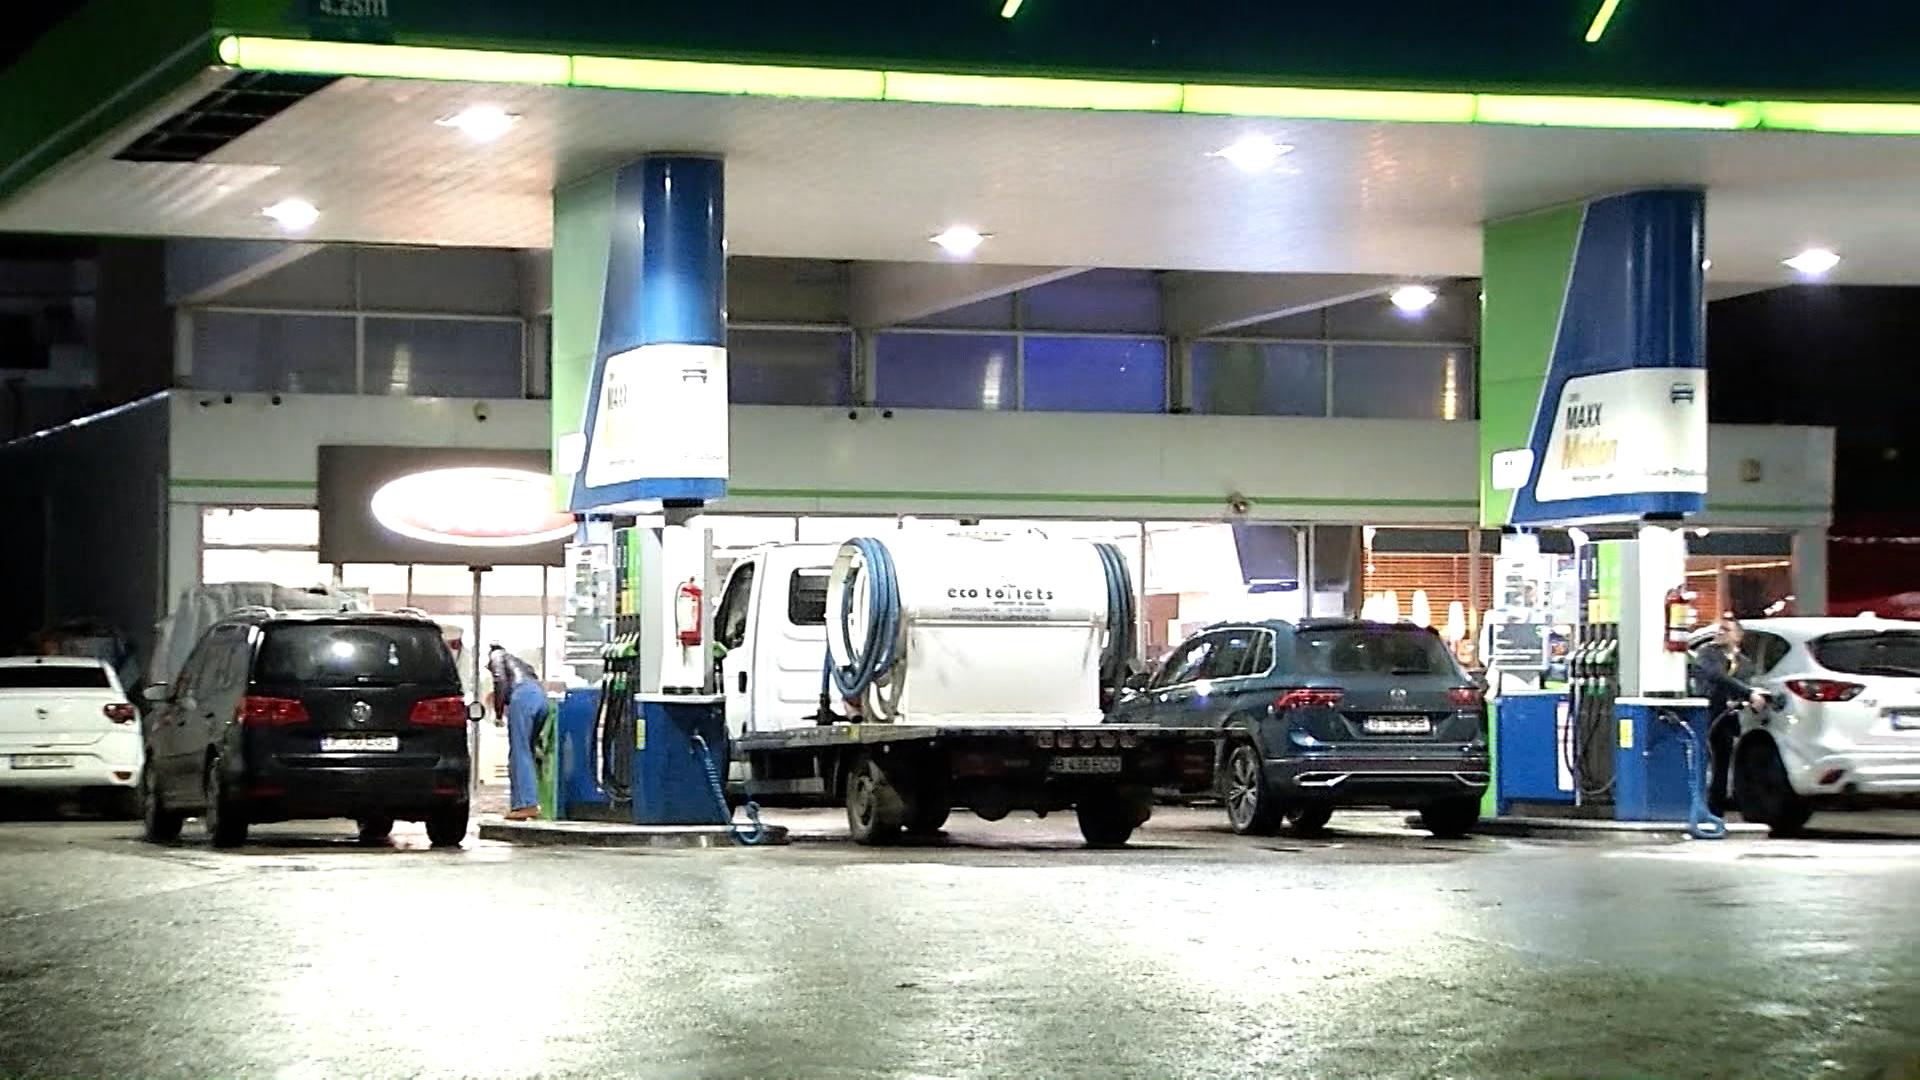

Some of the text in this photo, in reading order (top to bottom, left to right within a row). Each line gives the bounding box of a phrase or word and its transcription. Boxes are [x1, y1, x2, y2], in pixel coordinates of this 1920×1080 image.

[1566, 403, 1602, 430] MAXX
[947, 586, 1054, 600] eco toilets
